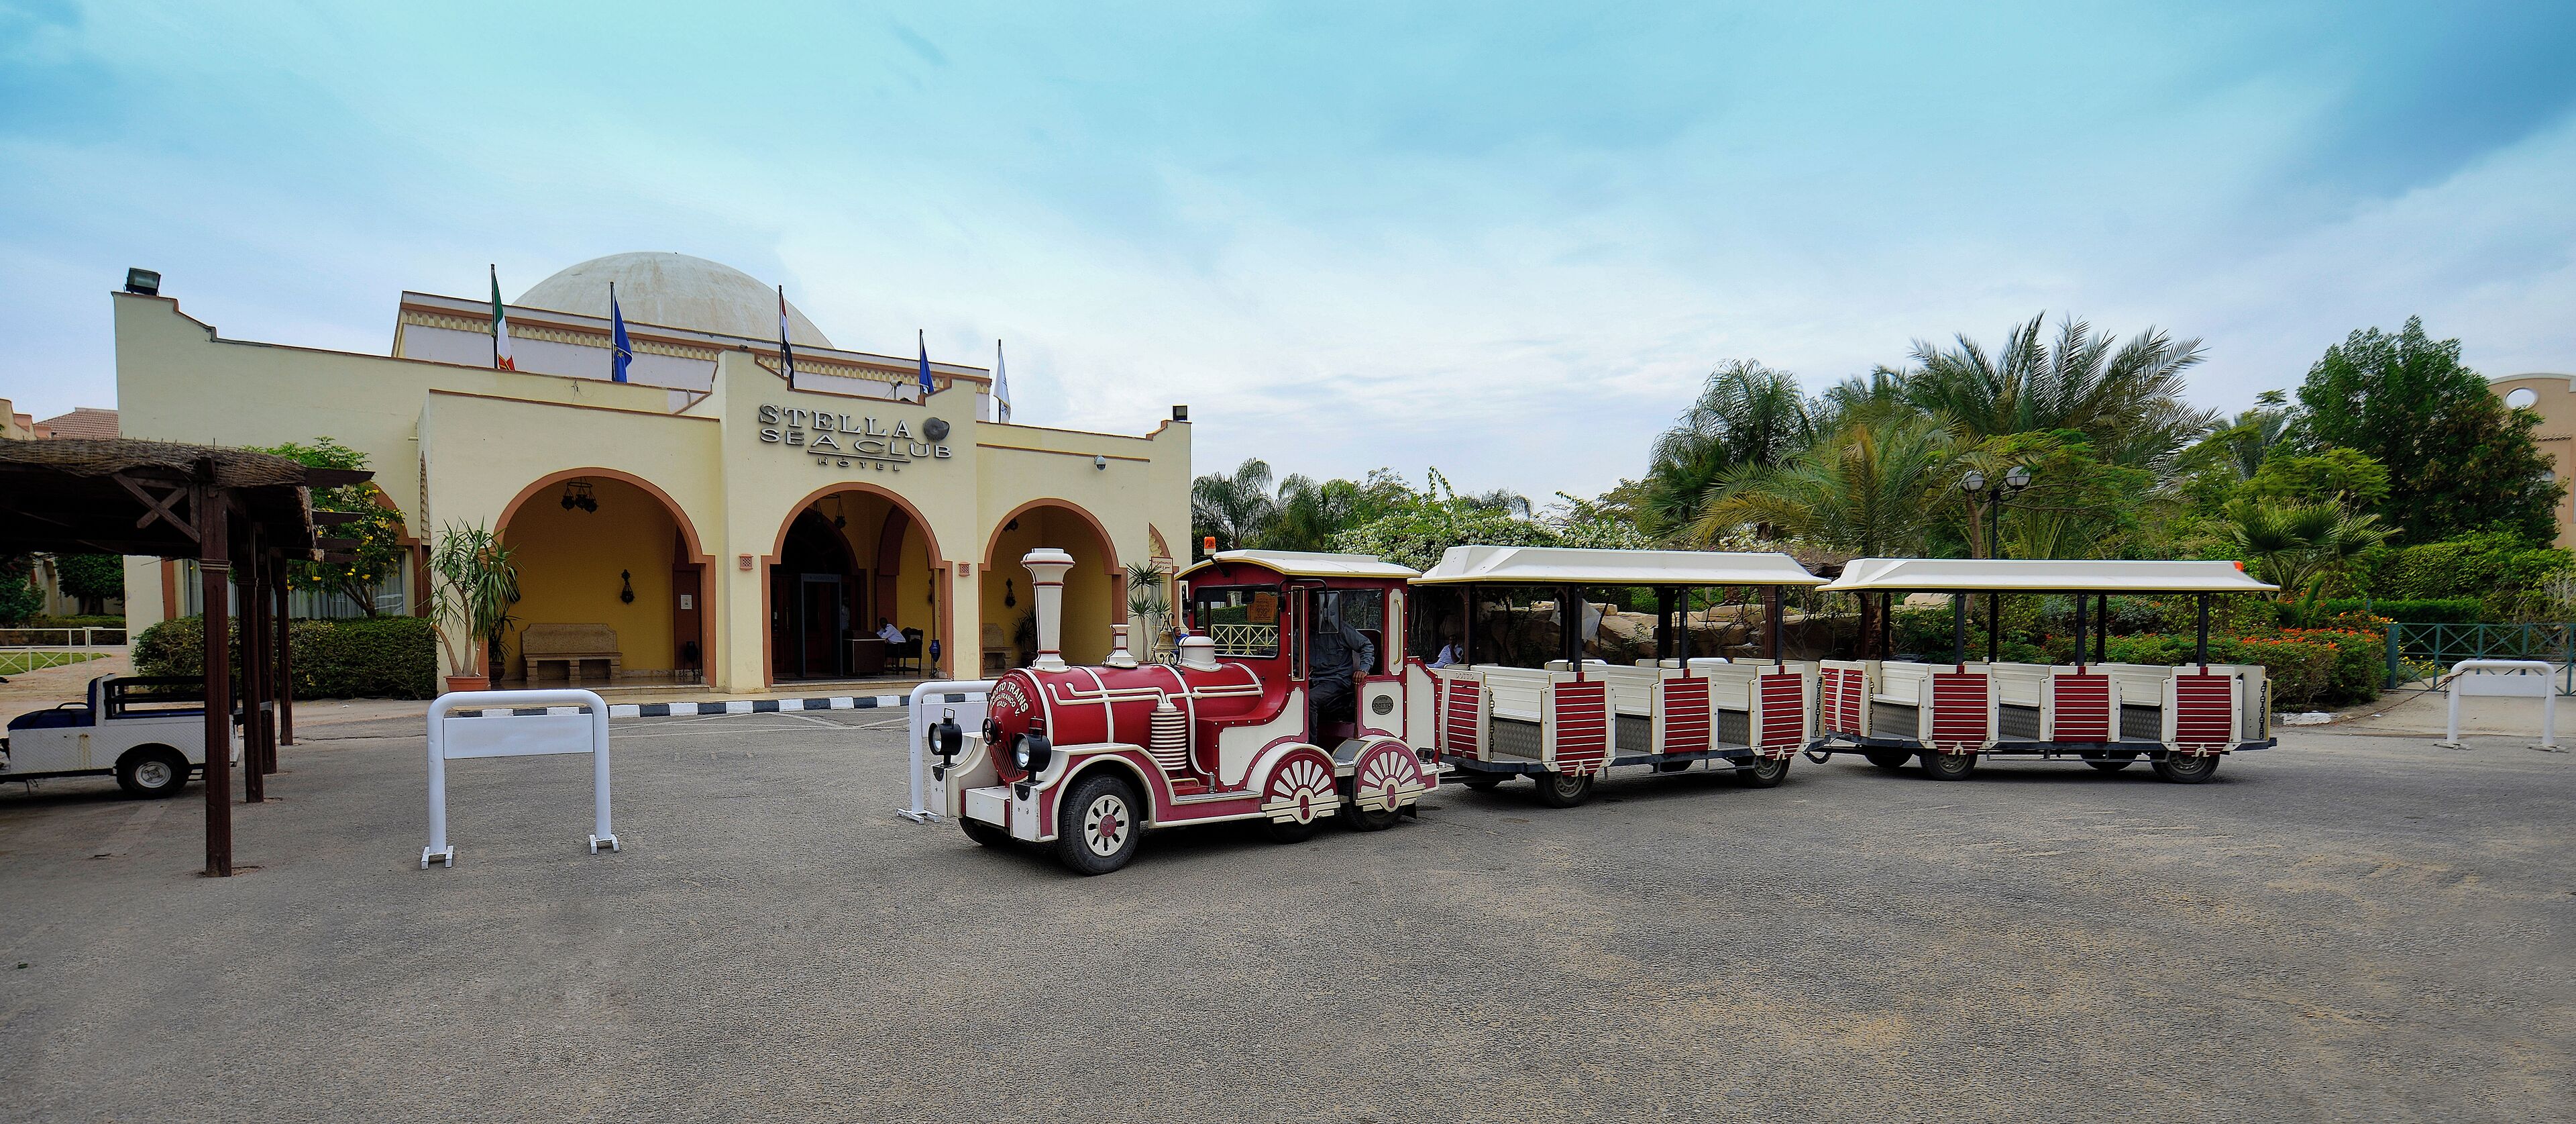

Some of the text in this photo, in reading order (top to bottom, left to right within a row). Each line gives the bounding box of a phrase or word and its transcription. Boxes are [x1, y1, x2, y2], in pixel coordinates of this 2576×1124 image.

[759, 404, 914, 438] STELLA
[760, 428, 951, 458] SEA CLUB
[818, 457, 900, 471] HOTEL
[1456, 672, 1474, 680] DOTTO
[1007, 682, 1028, 712] TRAINS
